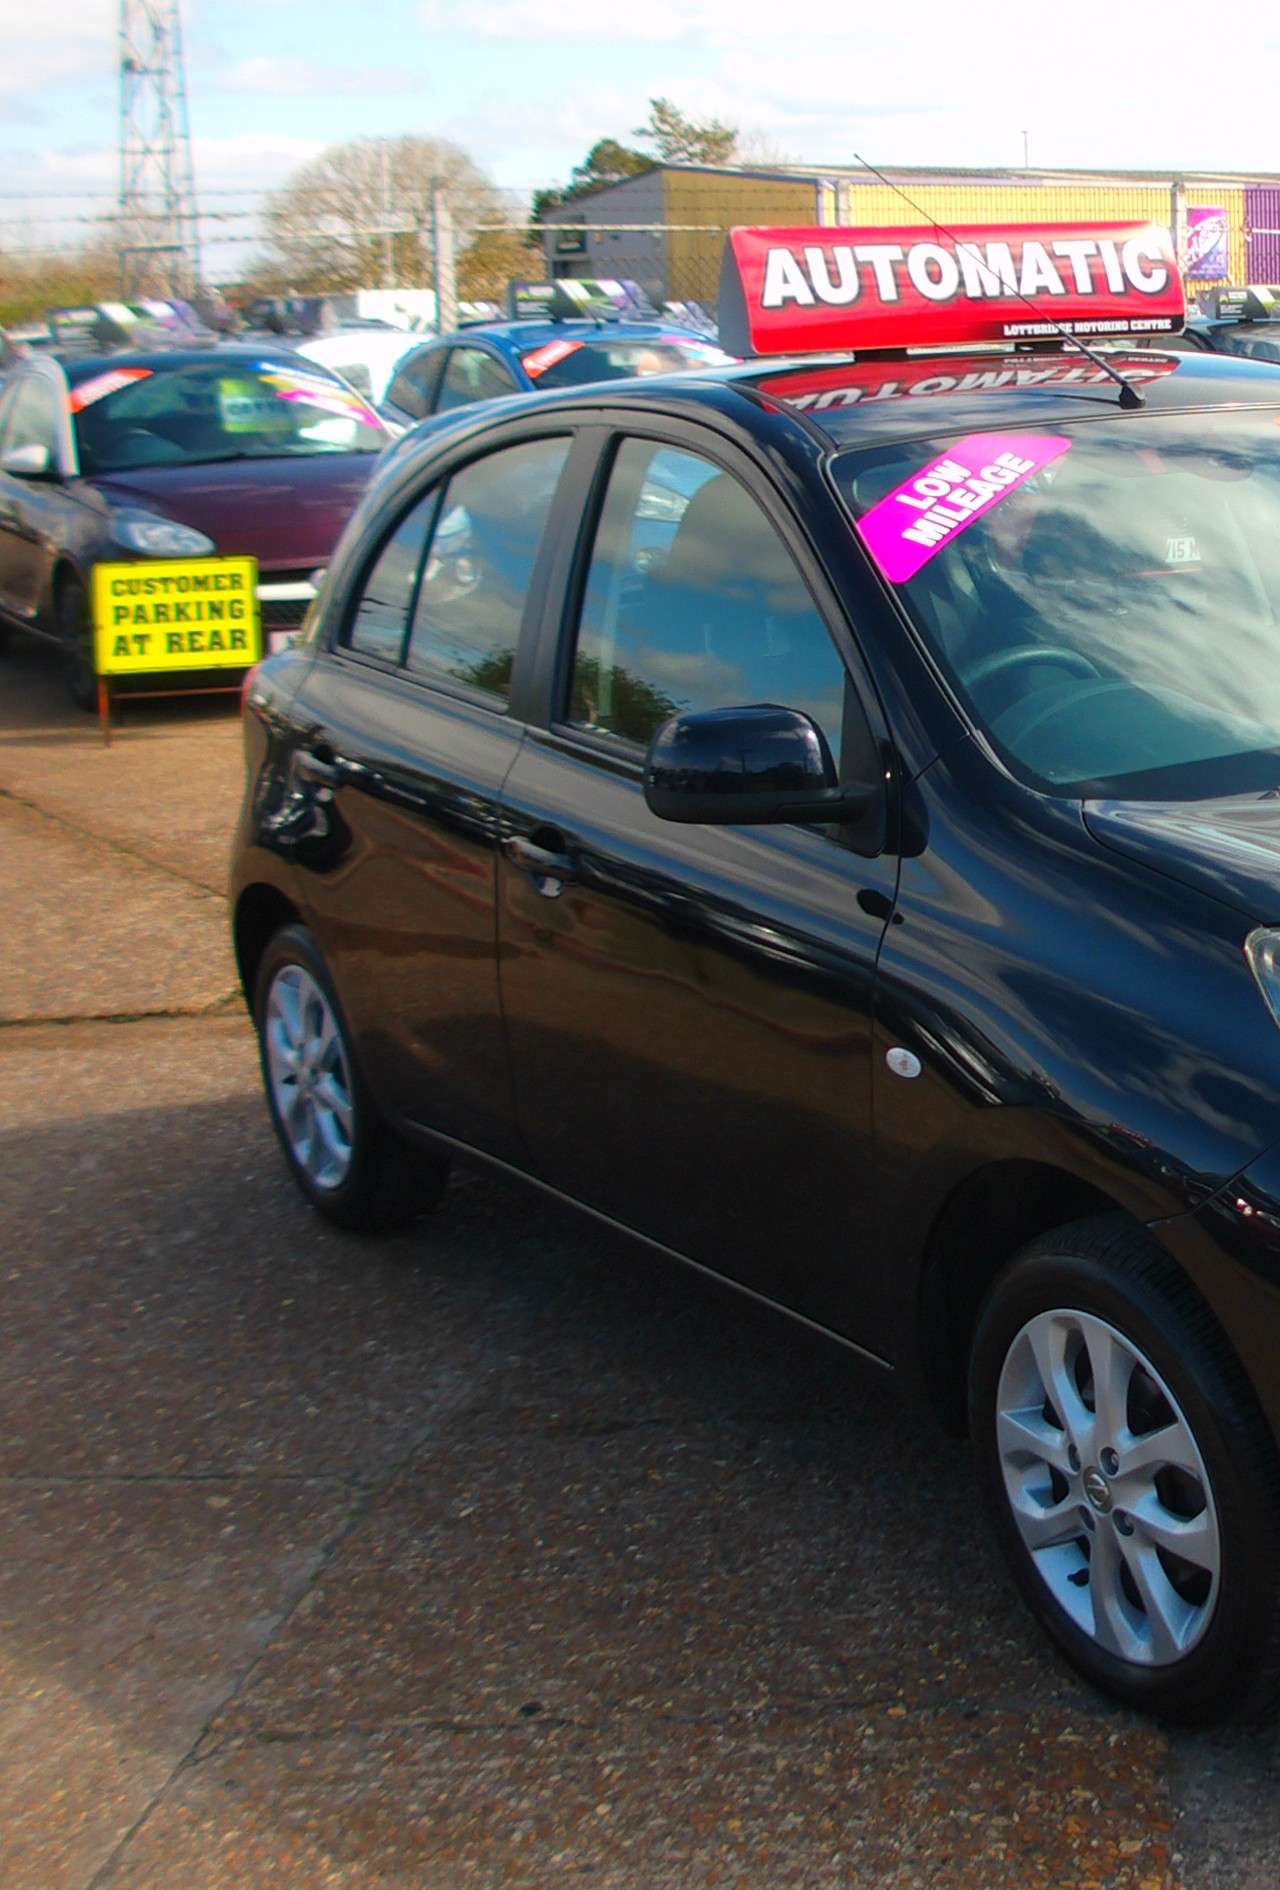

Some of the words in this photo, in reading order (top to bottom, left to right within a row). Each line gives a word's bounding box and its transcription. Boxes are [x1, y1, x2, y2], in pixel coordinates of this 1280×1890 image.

[762, 237, 1169, 307] AUTOMATIC
[1074, 320, 1128, 333] MOTORING
[1130, 319, 1171, 330] CENTRE
[896, 459, 972, 510] LOW
[901, 452, 1035, 547] MILEAGE
[111, 573, 243, 596] CUSTOMER
[113, 599, 245, 624] PARKING
[113, 633, 150, 656] AT
[166, 629, 248, 653] REAR
